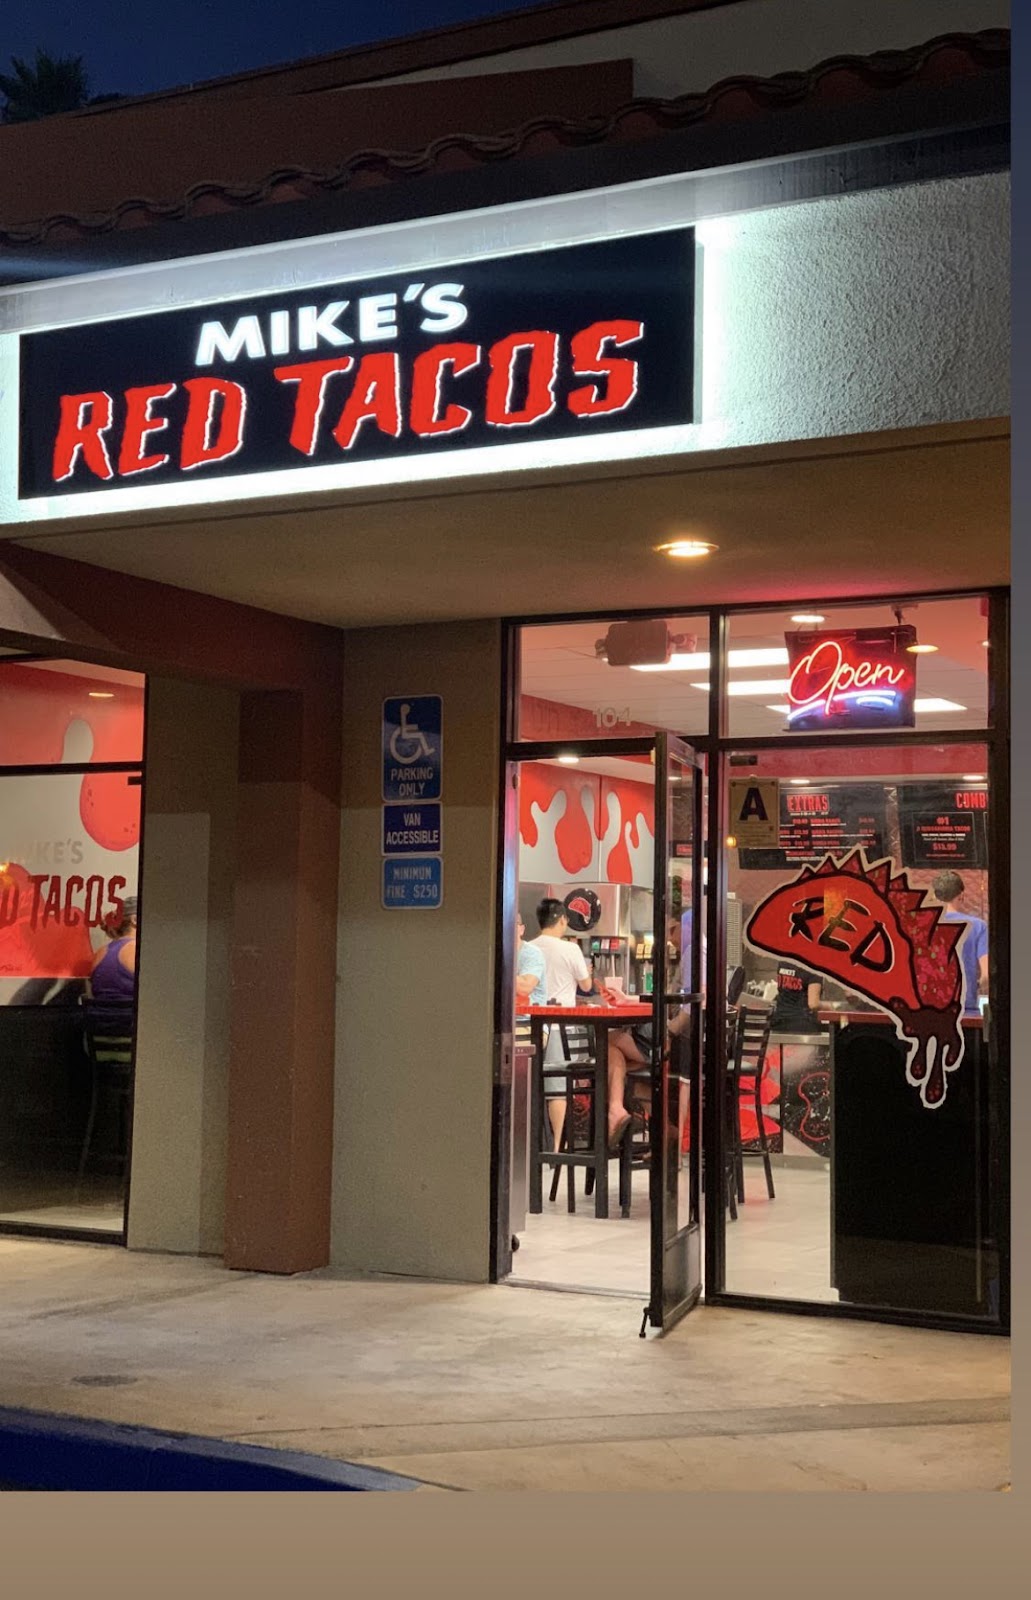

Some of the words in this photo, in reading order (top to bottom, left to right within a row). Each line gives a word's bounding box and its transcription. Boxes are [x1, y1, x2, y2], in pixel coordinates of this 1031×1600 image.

[196, 283, 468, 365] MIKE'S
[52, 377, 247, 481] RED
[274, 319, 644, 456] TACOS
[789, 641, 904, 715] Open
[593, 705, 632, 728] 104
[390, 767, 433, 782] PARKING
[399, 782, 425, 796] ONLY
[739, 787, 768, 820] A
[787, 795, 829, 812] EXTRAS
[403, 813, 421, 827] VAN
[386, 829, 439, 846] ACCESSIBLE
[393, 866, 432, 880] MINIMUM
[387, 885, 405, 899] FINE
[29, 875, 126, 933] TACOS
[789, 897, 895, 973] RED
